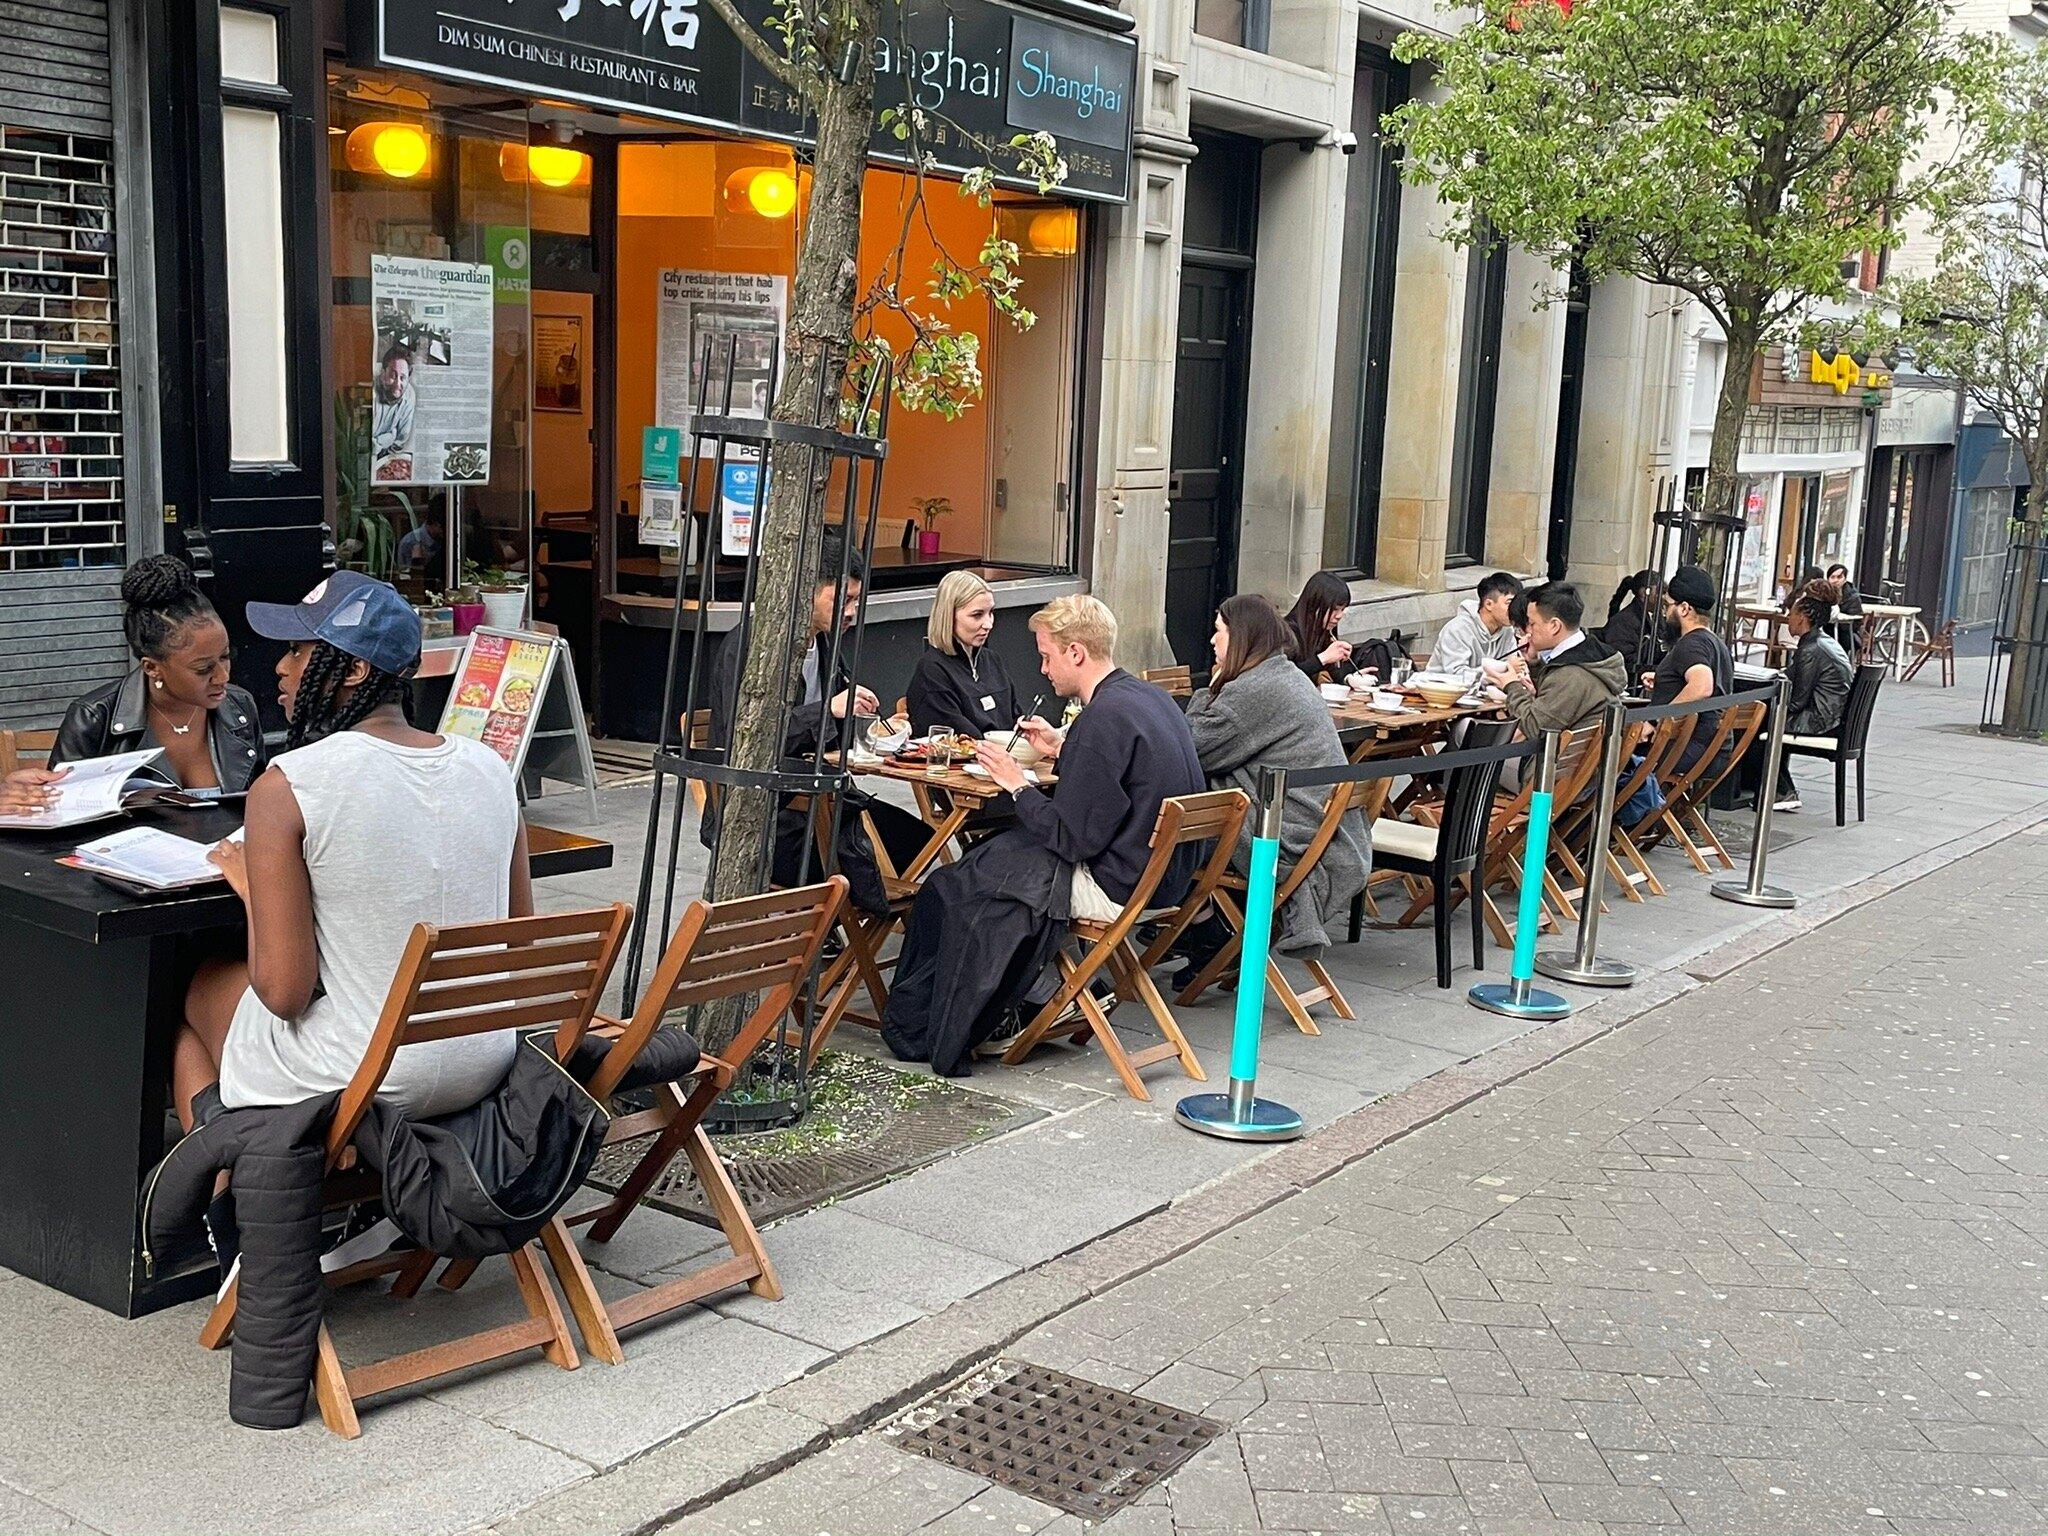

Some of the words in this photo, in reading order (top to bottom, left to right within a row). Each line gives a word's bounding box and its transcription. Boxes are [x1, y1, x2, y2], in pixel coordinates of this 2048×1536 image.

[437, 24, 471, 50] DIM
[472, 31, 505, 56] SUM
[508, 40, 567, 69] CHINESE
[570, 52, 656, 87] RESTAURANT
[658, 73, 670, 90] &
[673, 75, 699, 96] BAR
[1016, 47, 1123, 119] Shanghai
[420, 265, 491, 285] theguardian
[663, 271, 682, 286] City
[685, 273, 732, 287] restaurant
[735, 274, 754, 287] that
[757, 276, 773, 288] had
[663, 286, 678, 300] top
[681, 286, 704, 299] critic
[707, 287, 736, 303] licking
[738, 289, 752, 302] his
[755, 290, 771, 304] lips
